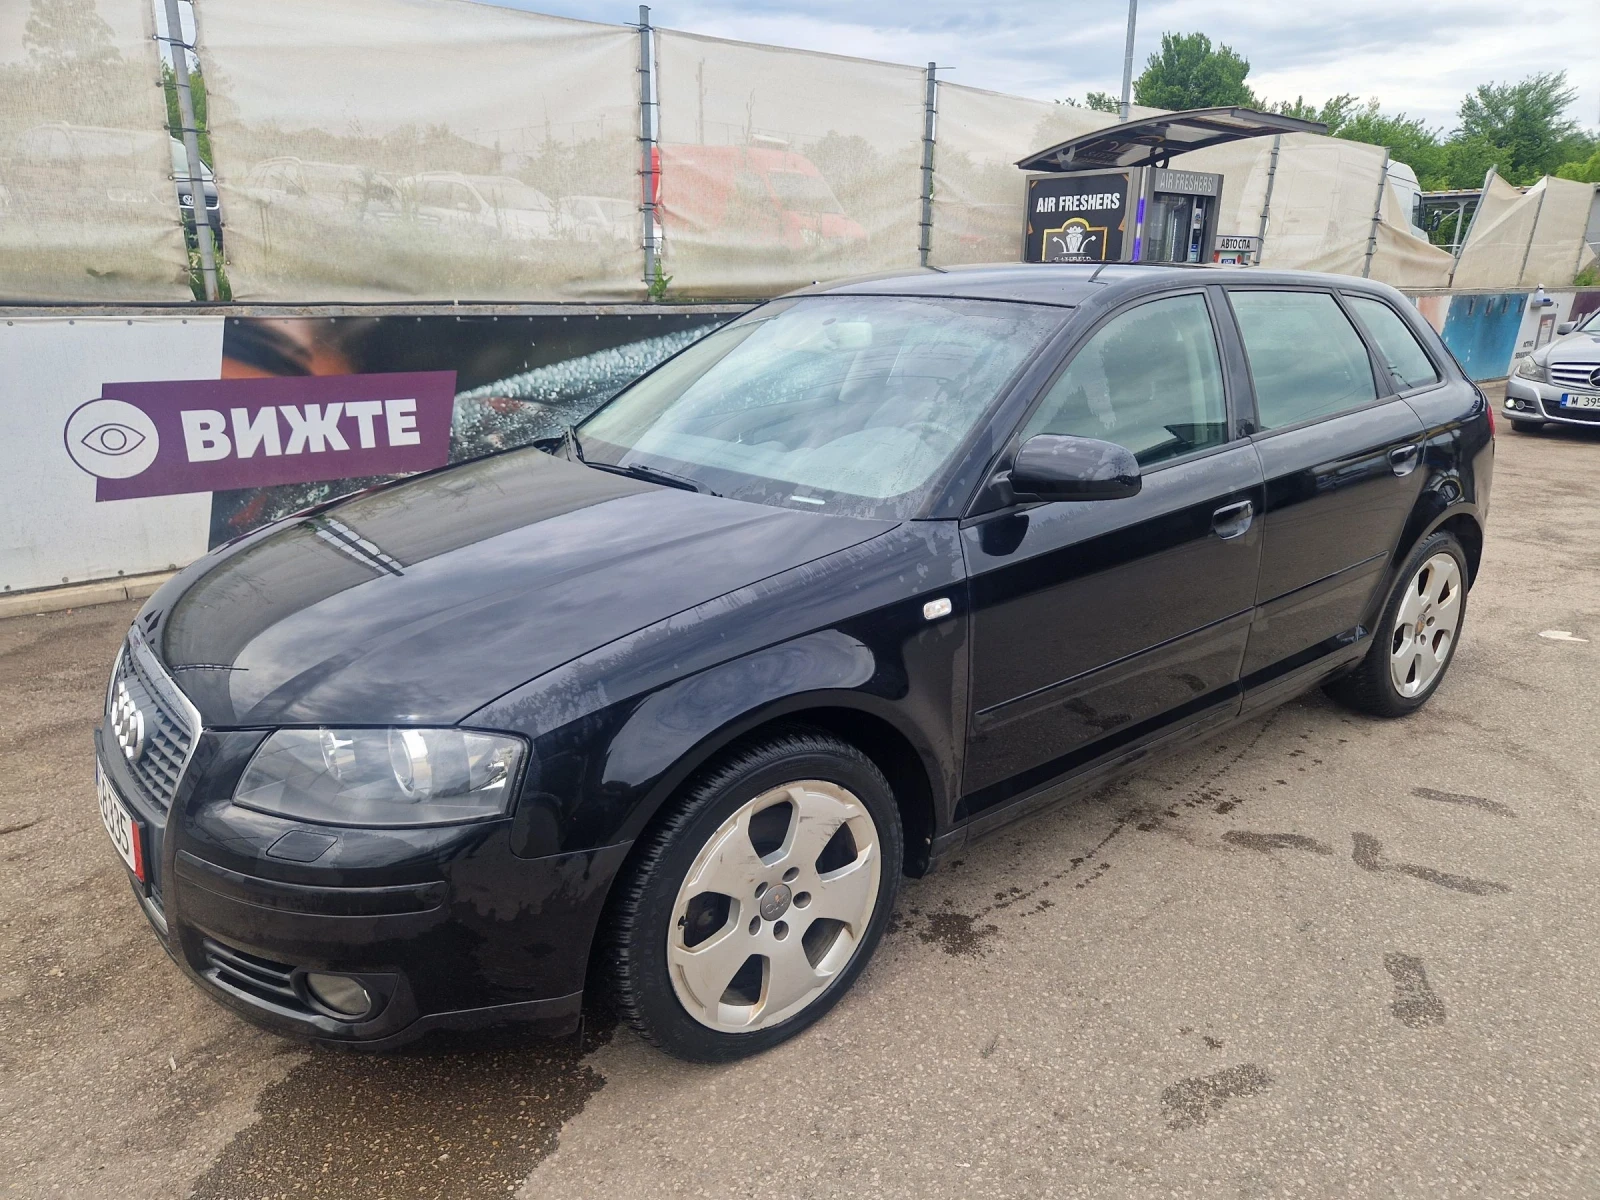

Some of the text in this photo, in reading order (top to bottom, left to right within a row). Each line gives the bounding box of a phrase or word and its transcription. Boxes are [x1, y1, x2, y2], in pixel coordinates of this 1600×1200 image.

[1160, 172, 1213, 192] AIR FRESHERS
[1036, 192, 1120, 213] AIR FRESHERS
[1220, 238, 1251, 249] АВТО СПА
[1571, 396, 1579, 406] M
[180, 398, 421, 463] ВИЖТЕ
